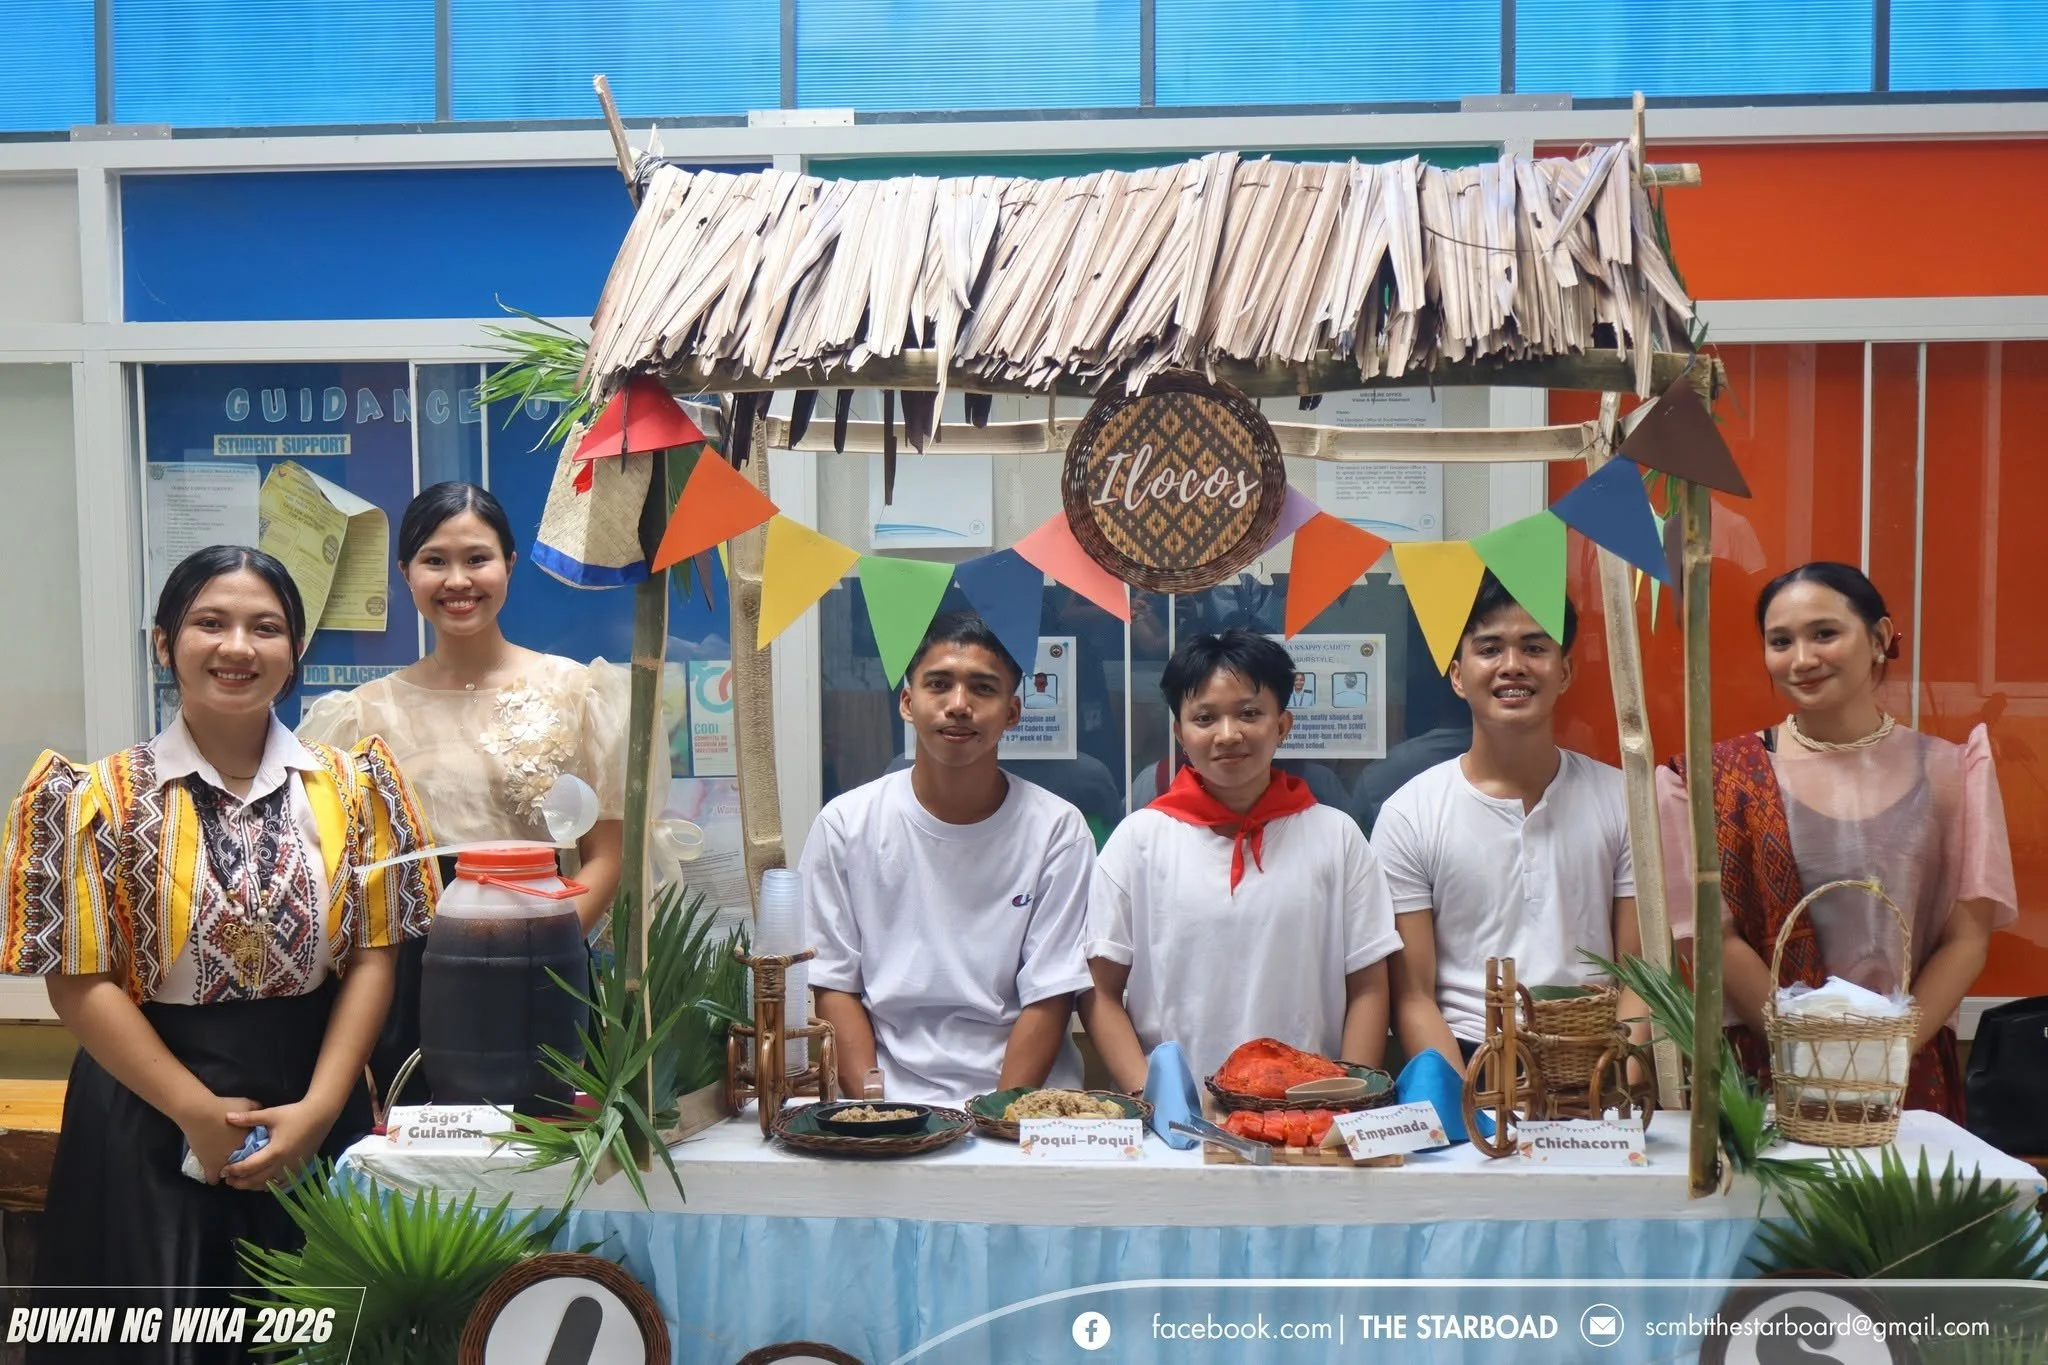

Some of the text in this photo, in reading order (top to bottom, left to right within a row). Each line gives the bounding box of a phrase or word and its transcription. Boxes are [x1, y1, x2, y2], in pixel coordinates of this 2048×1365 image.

[218, 436, 346, 453] STUDENT SUPPORT
[1092, 443, 1259, 511] Ilocos
[306, 666, 329, 682] JOB
[408, 1126, 483, 1139] Gulaman
[1356, 1120, 1429, 1141] Empanada
[1029, 1134, 1134, 1148] Poqui-Poqui
[1534, 1137, 1629, 1149] Chichacorn
